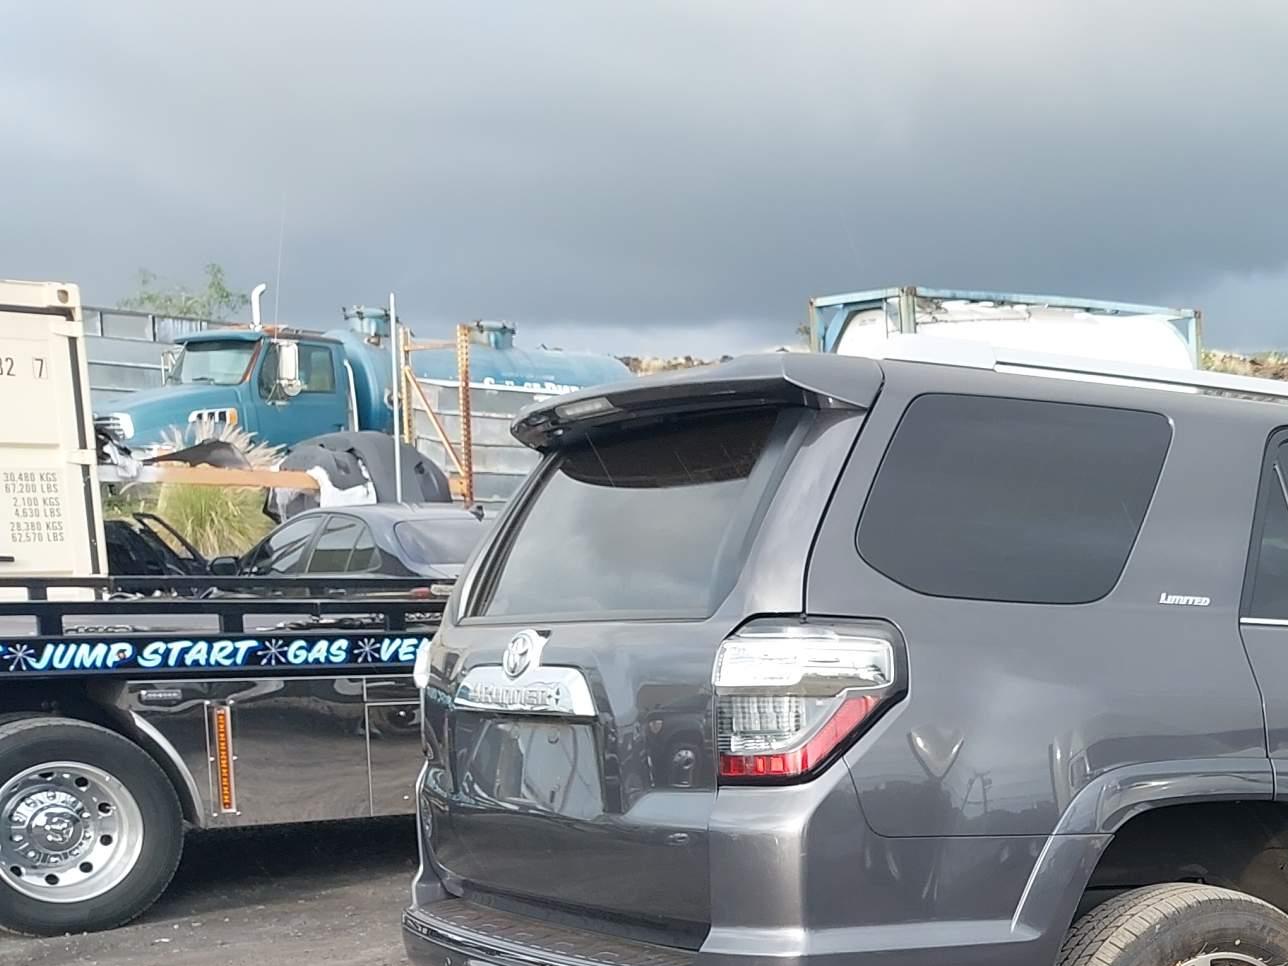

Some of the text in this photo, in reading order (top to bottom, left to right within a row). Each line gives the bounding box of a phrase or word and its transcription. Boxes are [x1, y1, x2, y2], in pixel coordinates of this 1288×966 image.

[34, 358, 44, 378] 7
[39, 472, 57, 482] KGS
[40, 483, 59, 493] LBS
[42, 497, 60, 507] KGS
[44, 508, 62, 518] LBS
[45, 521, 63, 531] KGS
[47, 532, 64, 542] LBS
[28, 641, 133, 670] JUMP
[137, 639, 259, 668] START
[287, 638, 349, 664] GAS
